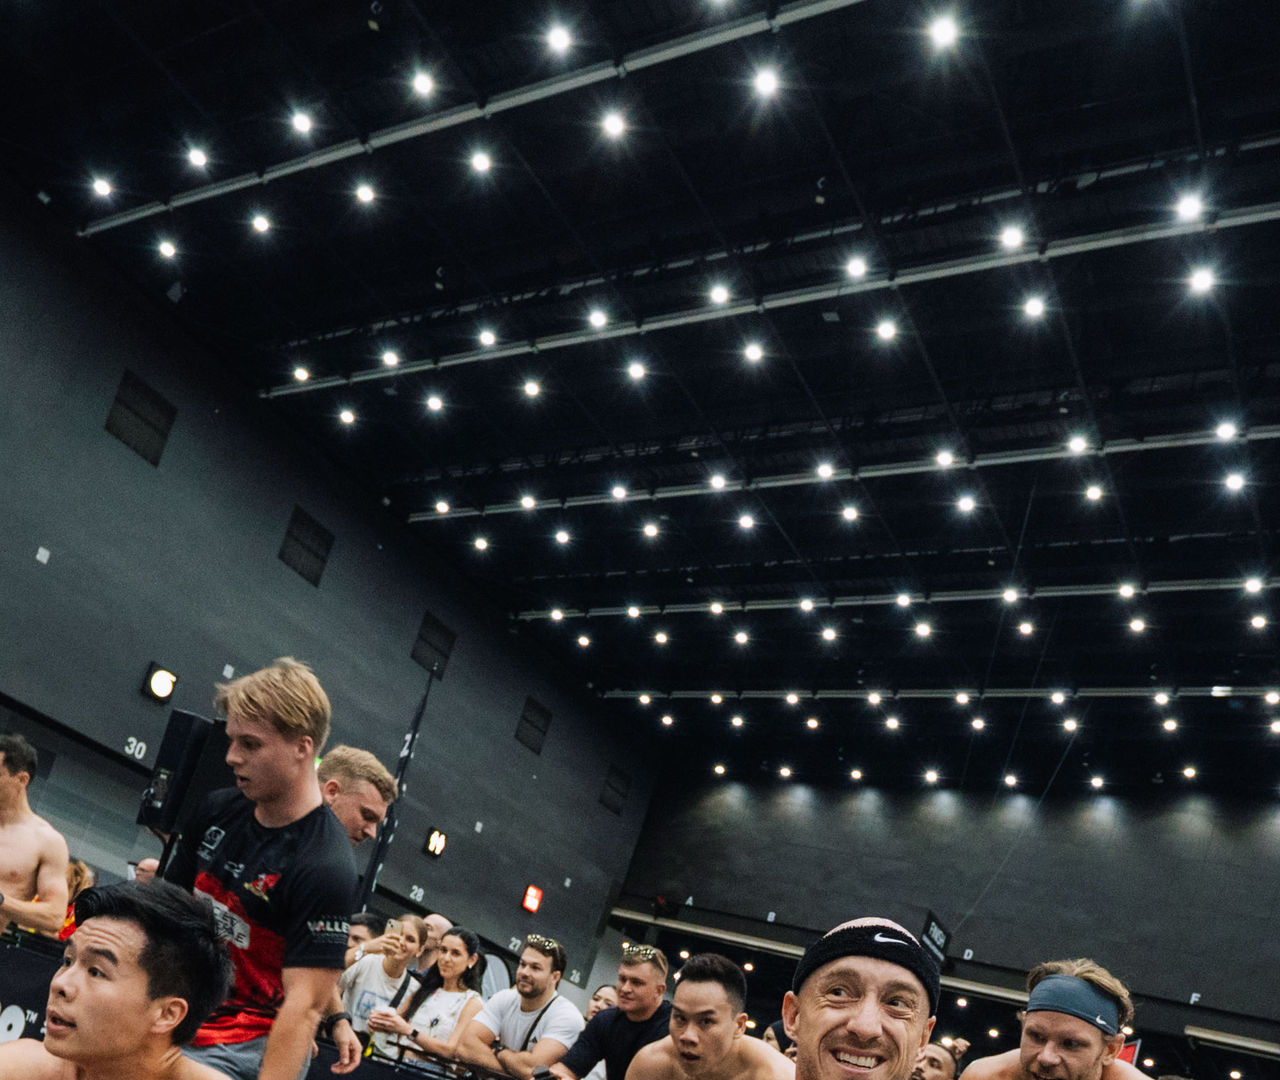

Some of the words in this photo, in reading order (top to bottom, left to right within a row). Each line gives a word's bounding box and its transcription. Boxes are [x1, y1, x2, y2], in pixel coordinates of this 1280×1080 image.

[124, 736, 147, 760] 30
[409, 884, 425, 902] 28
[684, 896, 694, 906] A
[766, 911, 777, 922] B
[963, 948, 974, 960] D
[1189, 992, 1201, 1005] F
